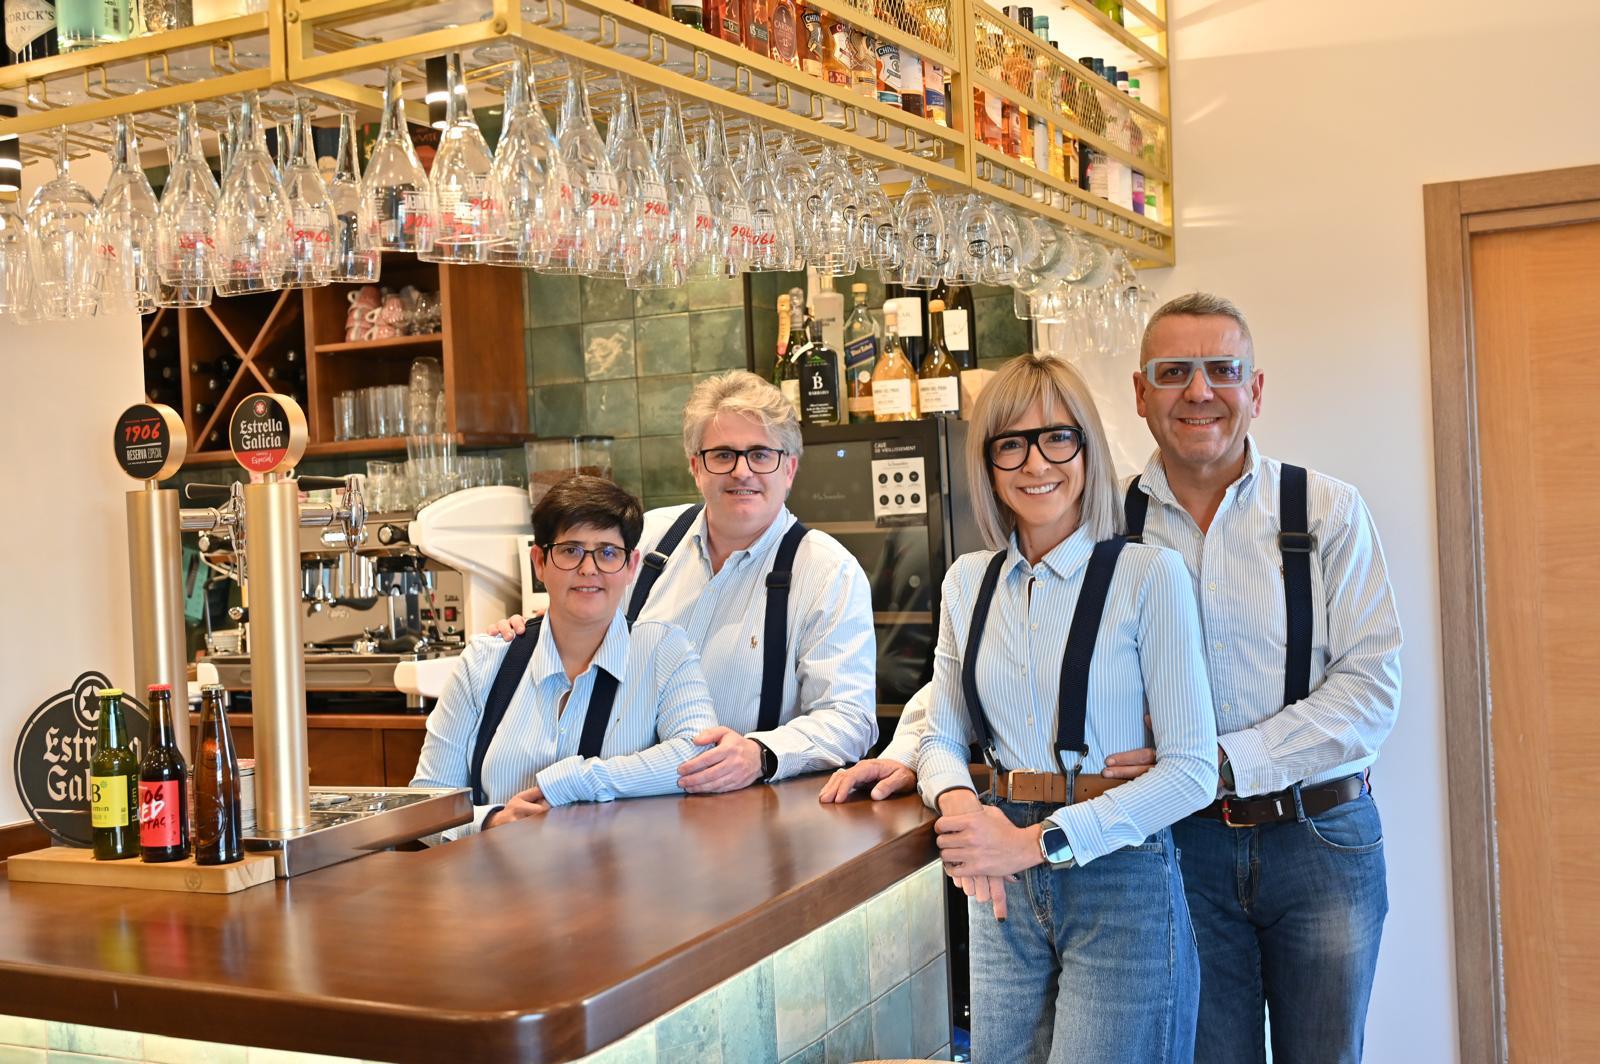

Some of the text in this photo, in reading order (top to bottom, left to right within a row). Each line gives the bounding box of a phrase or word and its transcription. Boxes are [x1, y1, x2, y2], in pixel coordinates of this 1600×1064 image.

[125, 422, 161, 444] 1906
[240, 418, 283, 435] Estrella
[242, 433, 281, 450] Galicia
[127, 449, 147, 460] RESERVA
